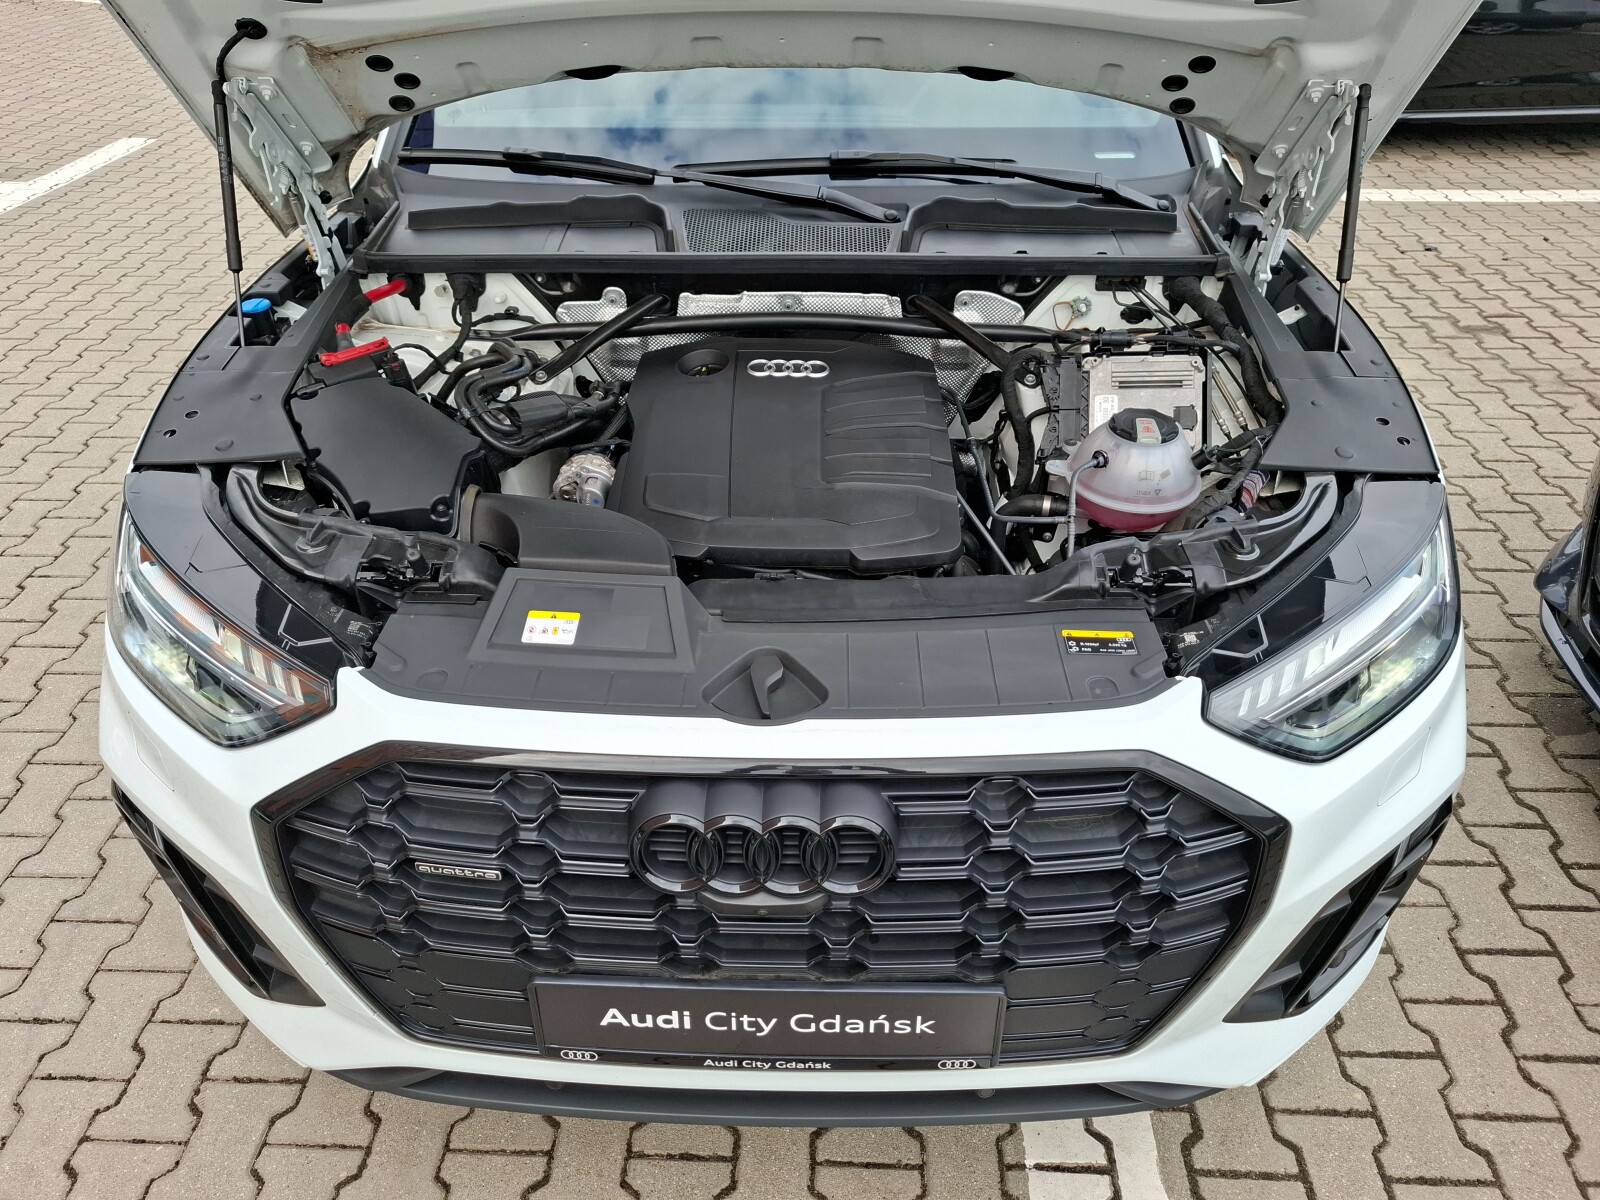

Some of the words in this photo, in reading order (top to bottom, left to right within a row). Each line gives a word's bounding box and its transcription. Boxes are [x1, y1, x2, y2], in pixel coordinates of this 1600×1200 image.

[418, 865, 497, 879] quattro
[600, 1008, 691, 1029] Audi
[705, 1012, 777, 1036] City
[790, 1013, 935, 1034] Gdańsk
[703, 1059, 738, 1068] Audi
[742, 1059, 772, 1070] City
[775, 1060, 832, 1069] Gdańsk
